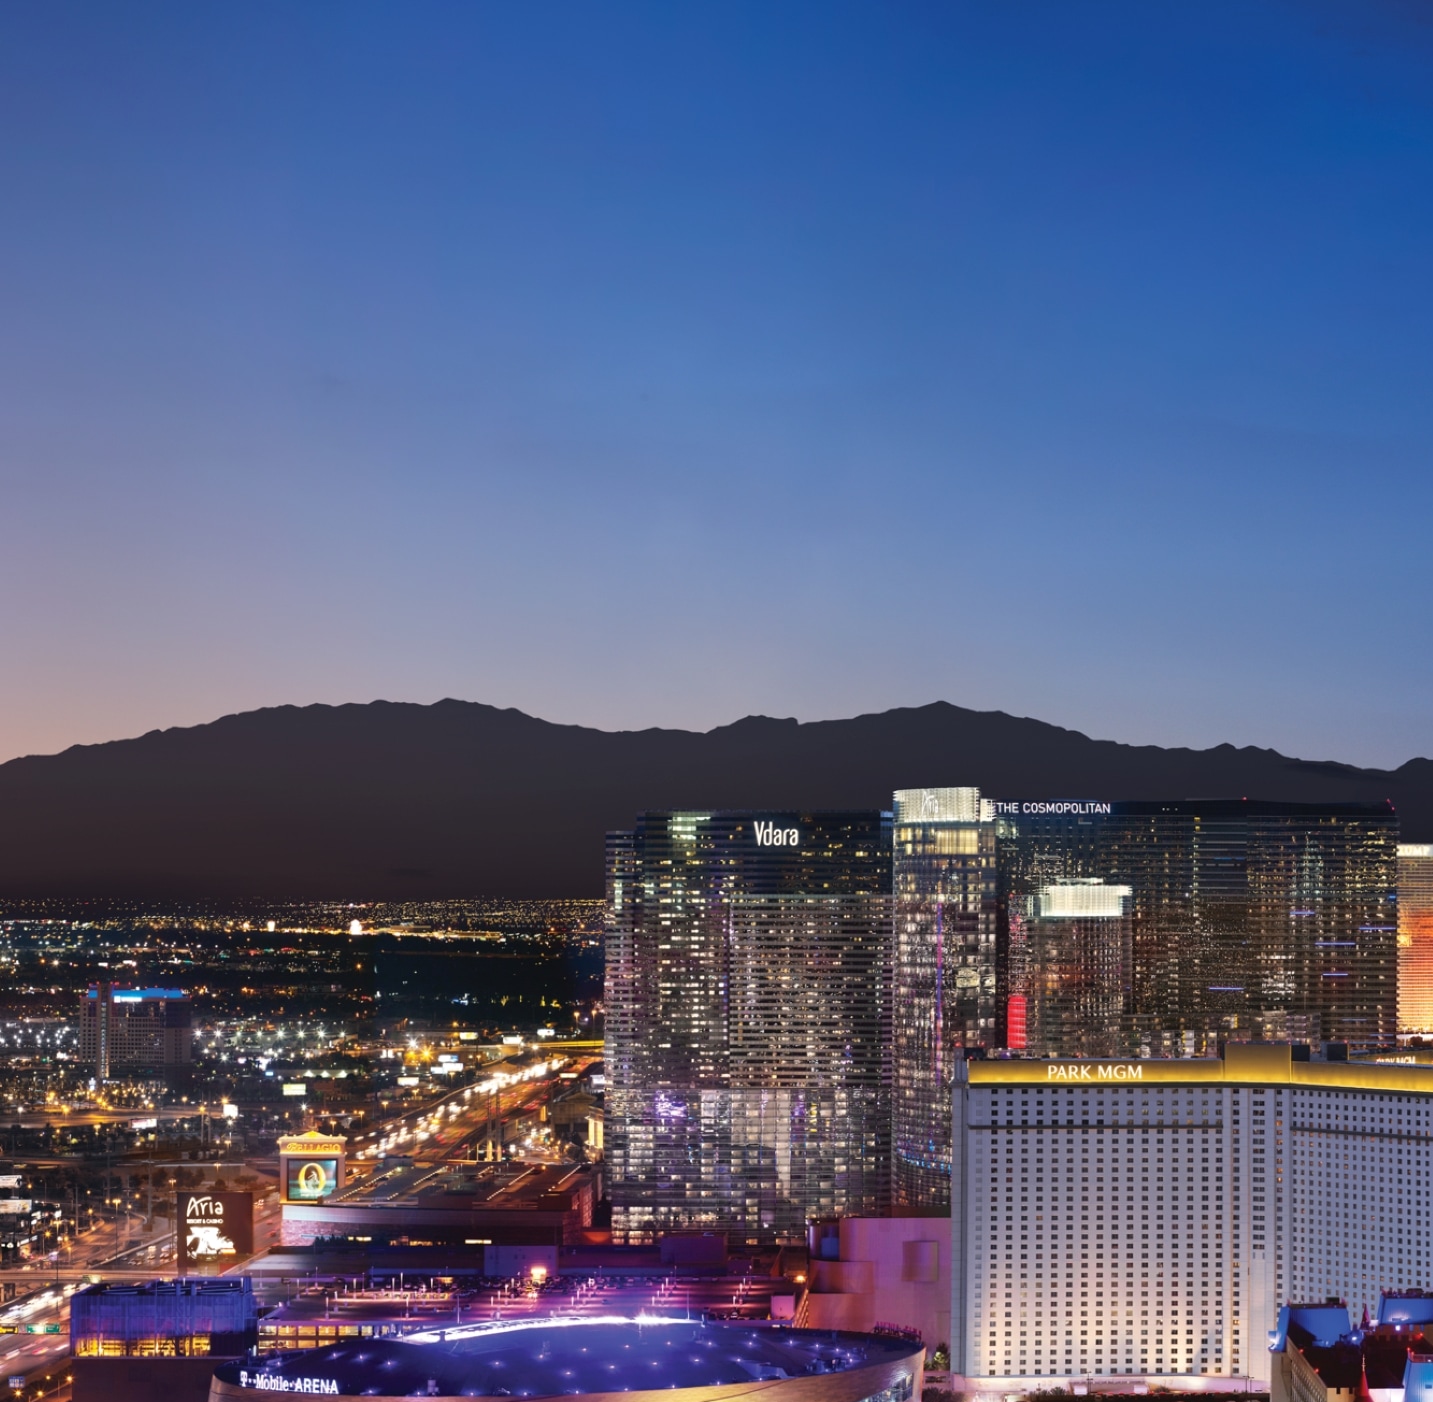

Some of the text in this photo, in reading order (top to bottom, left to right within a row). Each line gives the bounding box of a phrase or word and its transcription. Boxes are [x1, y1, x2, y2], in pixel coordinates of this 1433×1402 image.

[997, 802, 1111, 815] THE COSMOPOLITAN
[753, 821, 799, 846] Vdara
[1047, 1065, 1143, 1080] PARK MGM
[186, 1196, 224, 1217] Aria
[294, 1377, 340, 1395] ARENA
